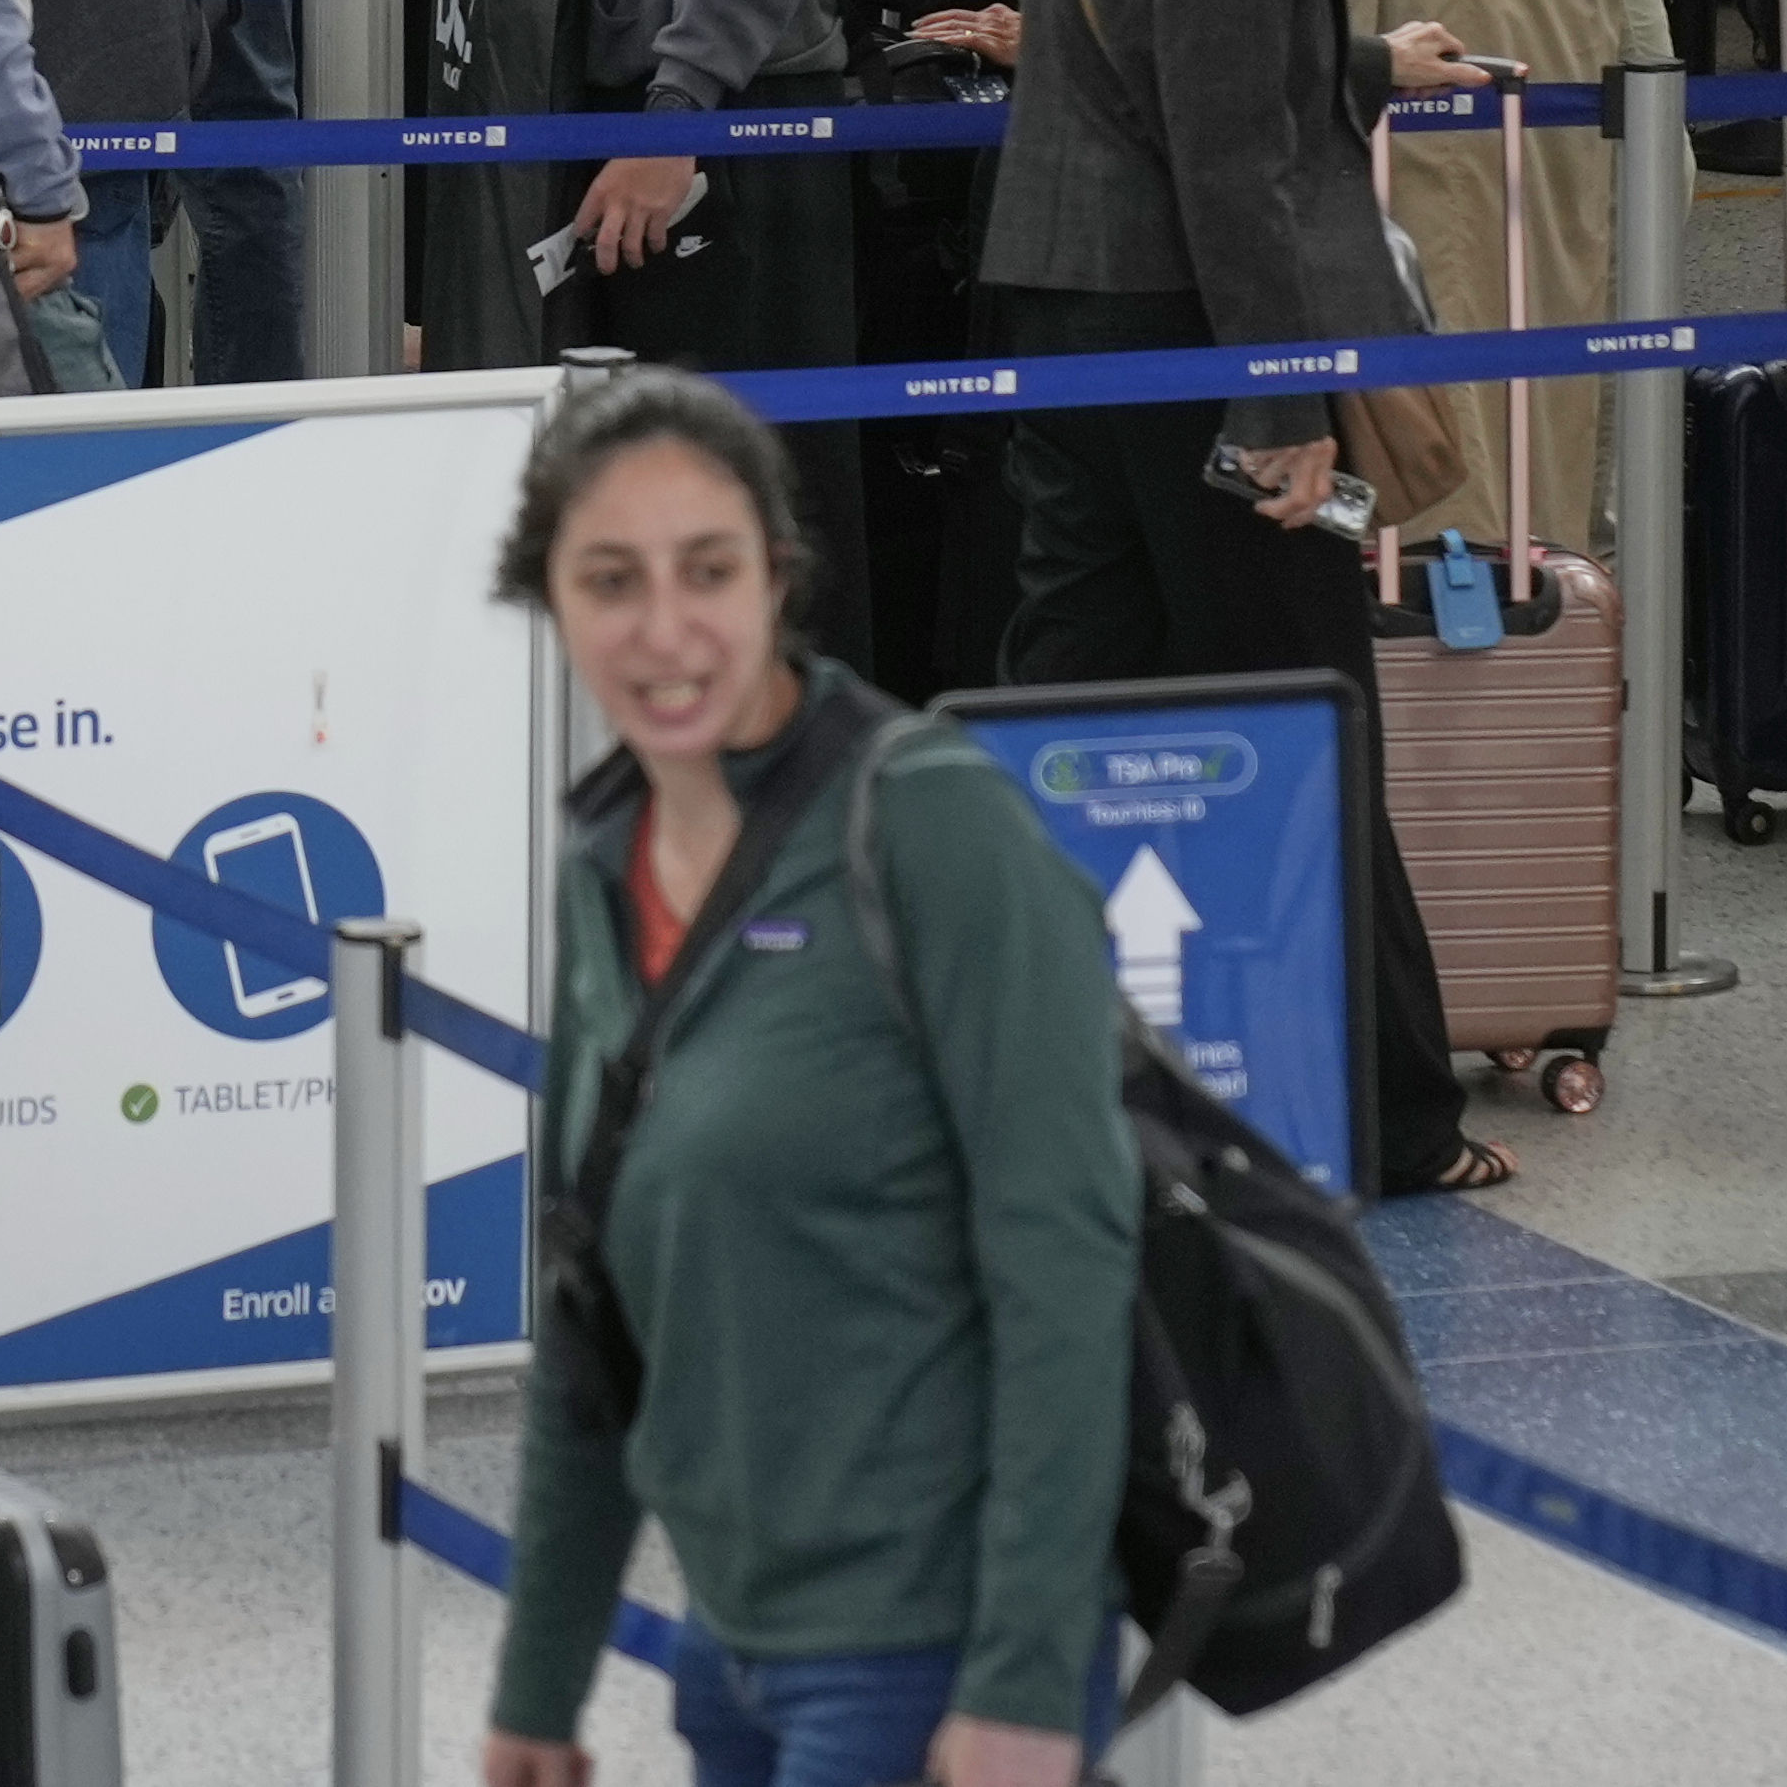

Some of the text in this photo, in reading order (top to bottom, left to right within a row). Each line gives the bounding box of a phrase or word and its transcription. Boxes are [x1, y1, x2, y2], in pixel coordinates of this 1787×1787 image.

[1387, 99, 1451, 114] NITED
[402, 130, 482, 146] UNITED
[729, 122, 809, 137] UNITED
[71, 136, 152, 151] UNITED
[1586, 334, 1671, 353] UNITED
[1248, 356, 1333, 375] UNITED
[906, 376, 991, 395] UNITED
[55, 699, 113, 748] in.
[222, 1282, 337, 1321] Enroll a
